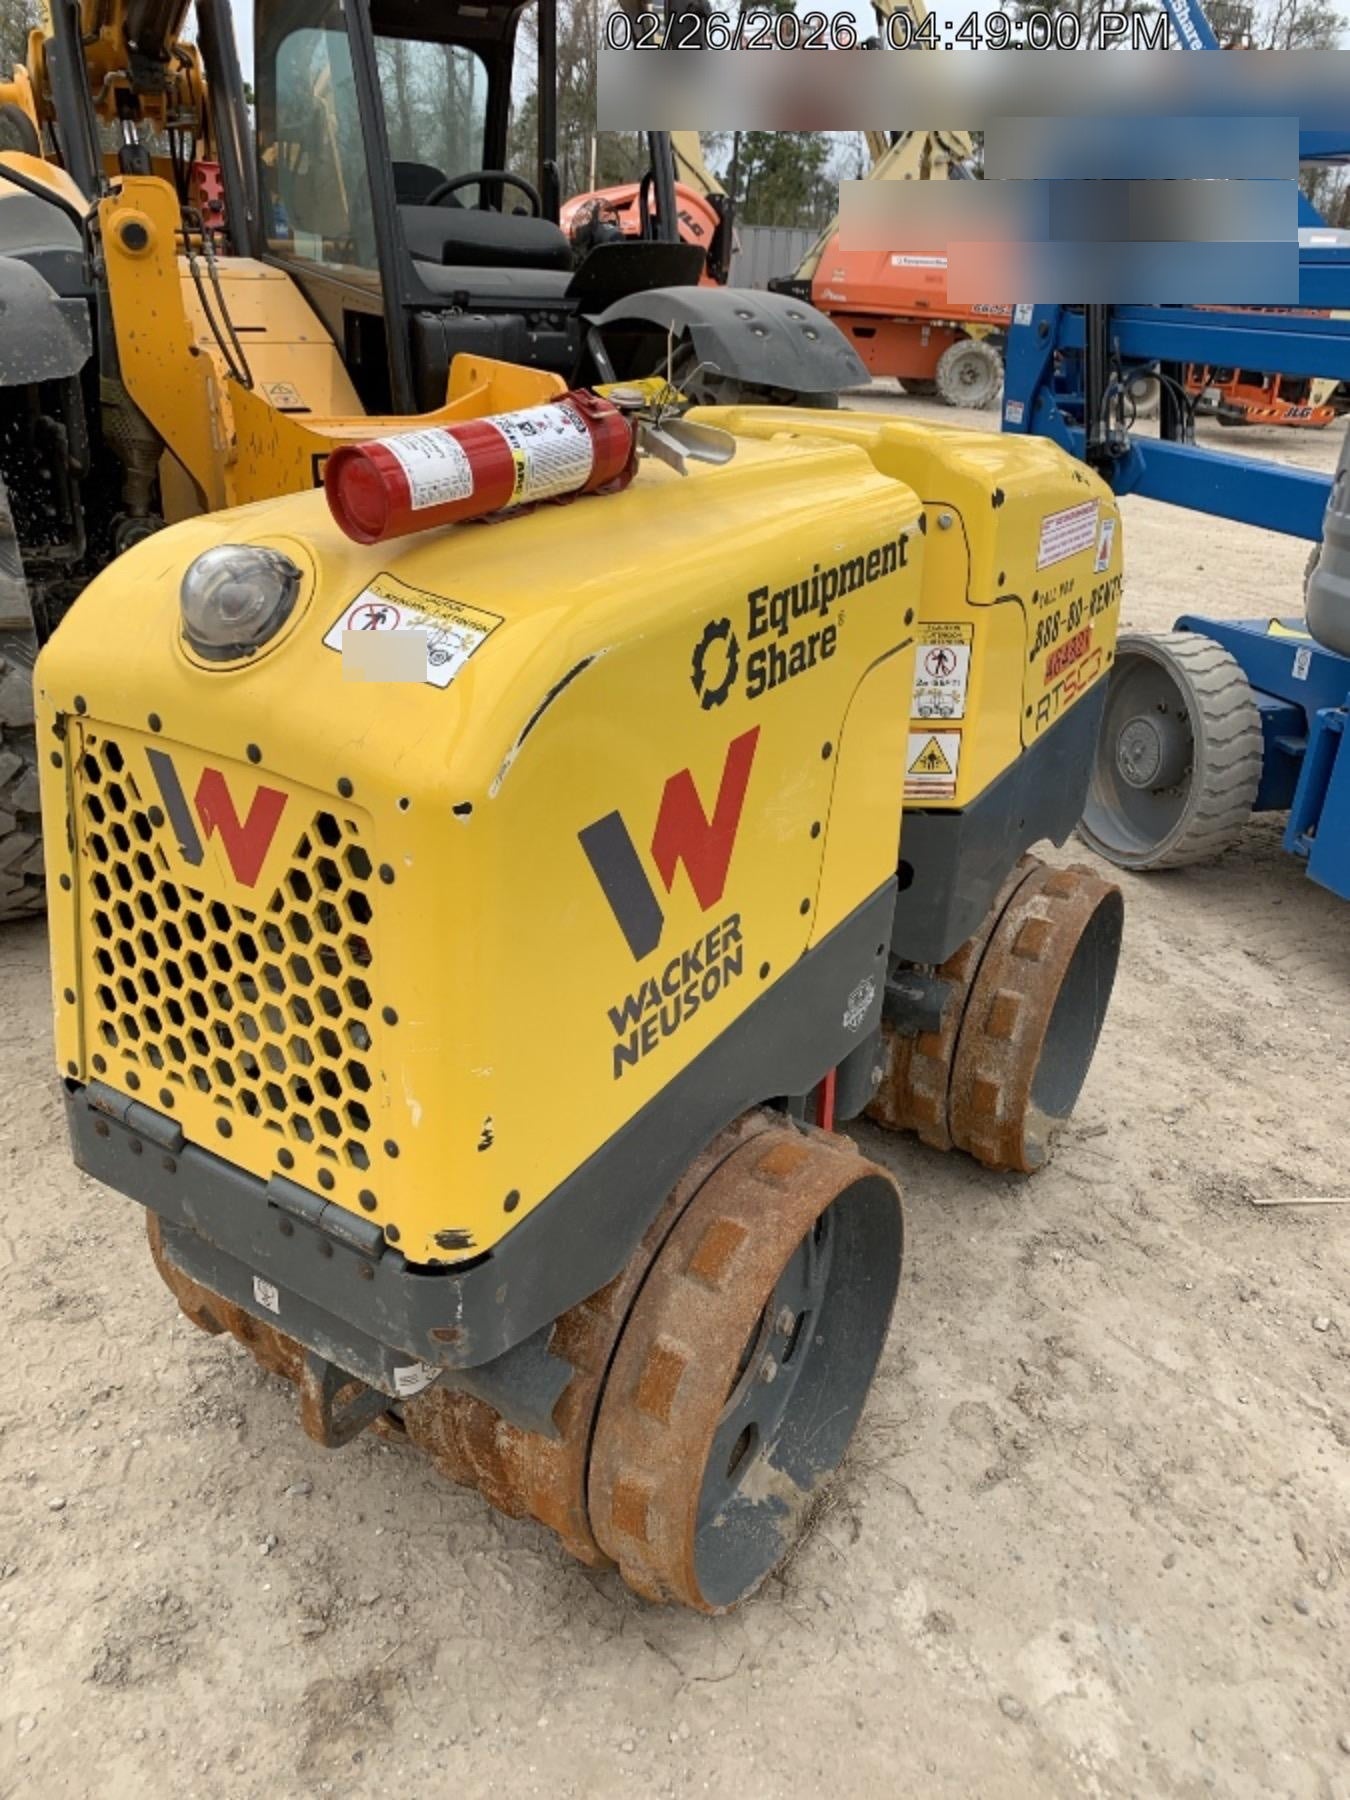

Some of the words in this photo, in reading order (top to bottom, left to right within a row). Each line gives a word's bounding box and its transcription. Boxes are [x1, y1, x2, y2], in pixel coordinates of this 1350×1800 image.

[1285, 406, 1313, 417] JLG
[747, 532, 909, 641] Equipment
[745, 623, 837, 700] Share
[607, 912, 743, 1037] WACKER
[613, 943, 743, 1081] NEUSON
